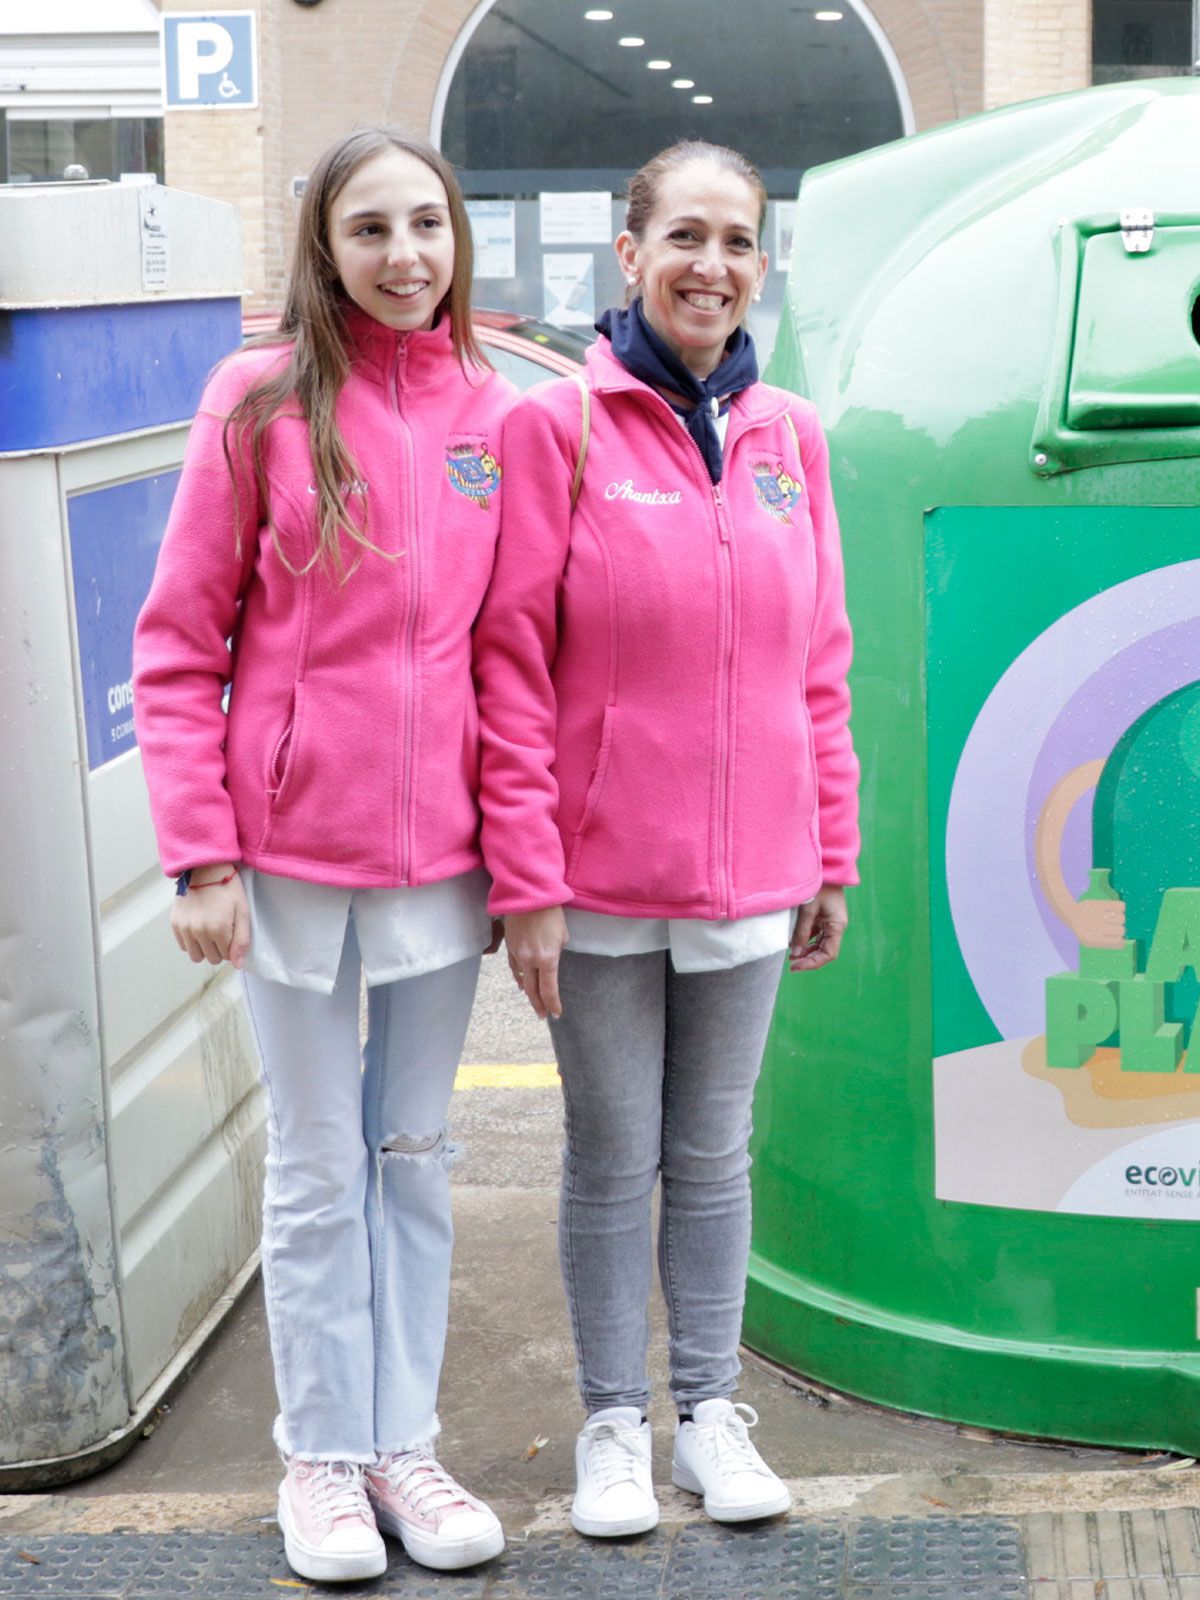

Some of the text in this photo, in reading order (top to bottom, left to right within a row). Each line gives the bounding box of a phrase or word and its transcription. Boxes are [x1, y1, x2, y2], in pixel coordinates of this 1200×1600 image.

[177, 22, 233, 99] P
[1124, 1188, 1162, 1197] ENTITAT
[1165, 1190, 1193, 1199] SENSE
